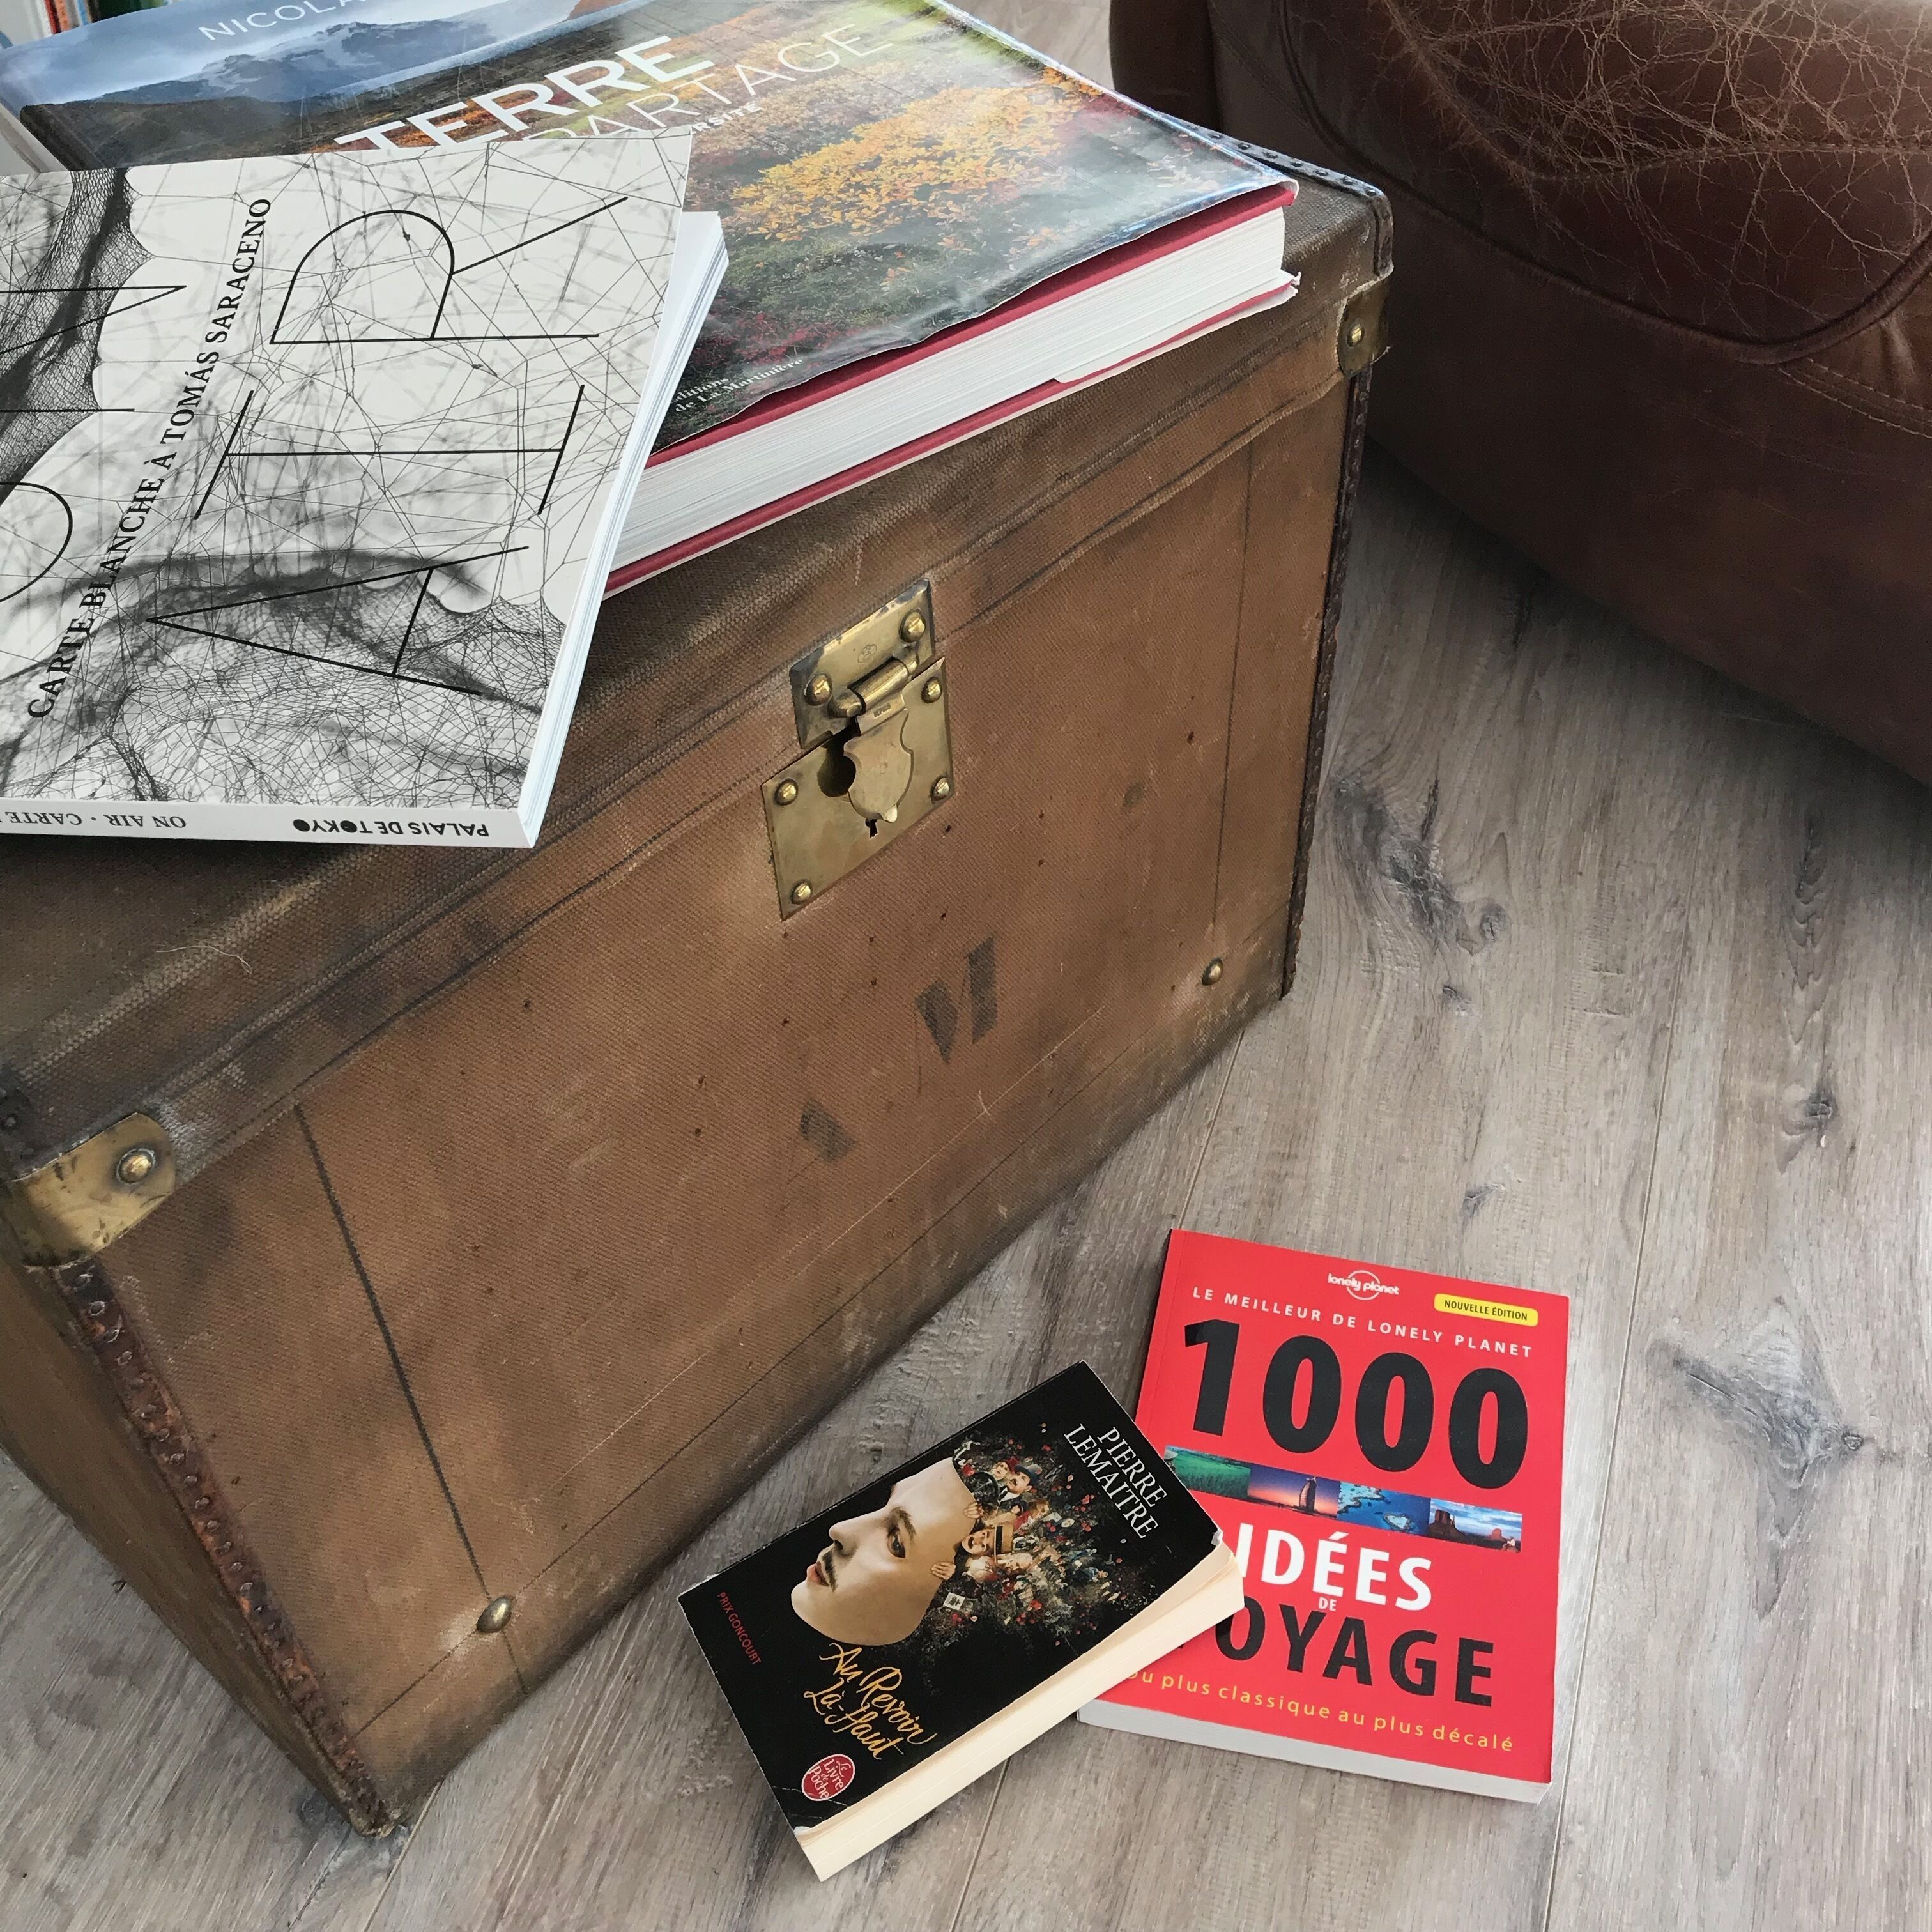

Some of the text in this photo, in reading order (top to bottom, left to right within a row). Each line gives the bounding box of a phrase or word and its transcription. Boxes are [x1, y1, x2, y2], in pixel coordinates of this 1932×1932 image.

[197, 0, 366, 40] NICOL
[334, 36, 716, 149] TERRE
[692, 101, 762, 134] RSITÉ
[673, 378, 729, 402] ditions
[675, 359, 803, 412] de La Martinière
[27, 199, 272, 719] CARTE BLANCHE À TOMÁS SARACENO
[5, 811, 187, 829] ON AIR CARTE
[408, 822, 490, 837] PALAIS
[1328, 1273, 1400, 1296] lonely planet
[1444, 1300, 1528, 1321] NOUVELLE ÉDITION
[1193, 1287, 1532, 1358] LE MEILLEUR DE LONELY PLANET
[1184, 1319, 1528, 1490] 1000
[1063, 1423, 1159, 1539] LEMAITRE
[1097, 1426, 1168, 1508] PIERRE
[1236, 1522, 1432, 1611] IDÉES
[717, 1591, 761, 1666] PRIX GONCOURT
[1318, 1597, 1337, 1612] DE
[1178, 1595, 1494, 1707] OYAGE
[819, 1643, 938, 1745] Au Revoir
[1162, 1675, 1210, 1696] plus
[1218, 1685, 1330, 1717] classique
[1338, 1710, 1365, 1726] au
[1374, 1715, 1424, 1736] plus
[1432, 1725, 1514, 1752] décalé
[807, 1765, 829, 1799] Poche
[823, 1758, 844, 1790] Livre
[836, 1760, 852, 1778] Le
